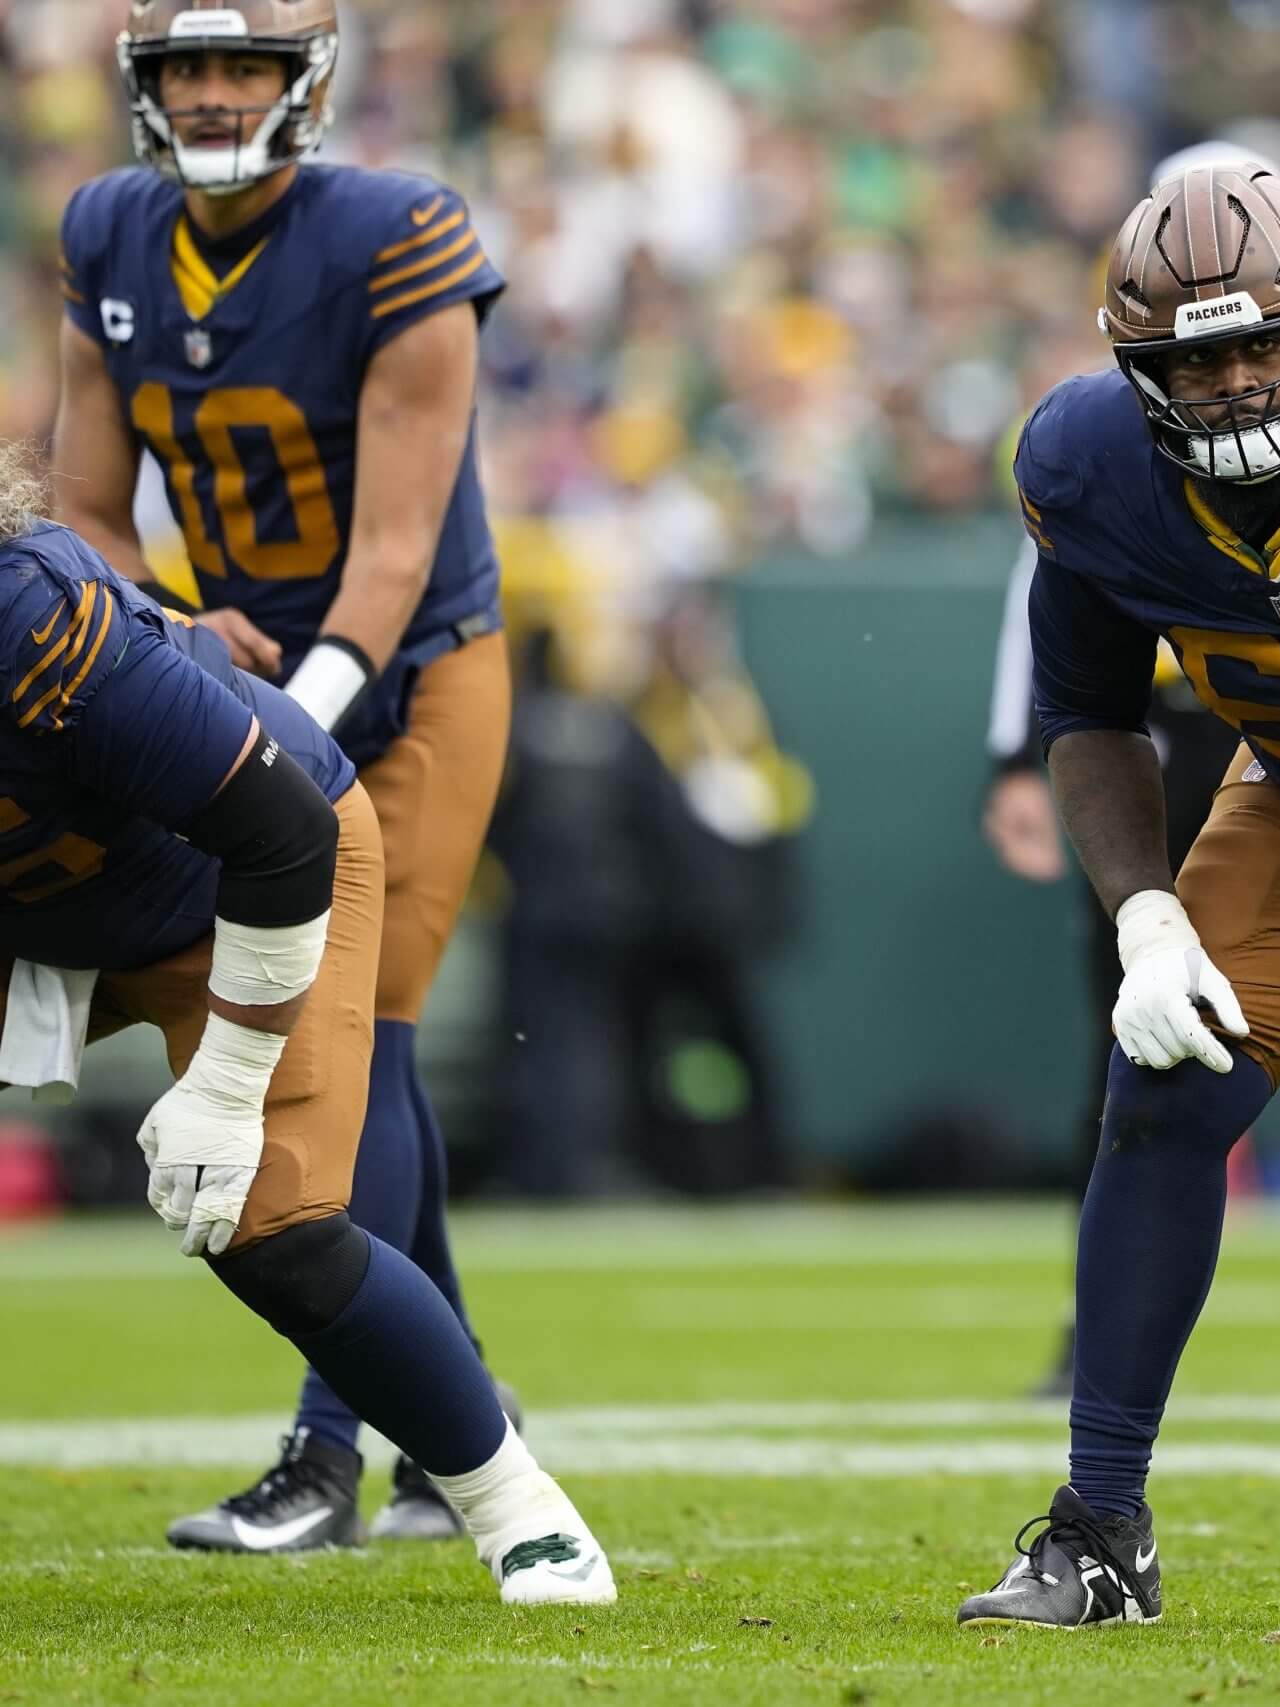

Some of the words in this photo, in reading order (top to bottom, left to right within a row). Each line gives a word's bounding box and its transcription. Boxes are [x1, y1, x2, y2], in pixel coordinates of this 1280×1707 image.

[100, 297, 135, 342] C
[1186, 302, 1242, 322] PACKERS
[131, 380, 341, 580] 10
